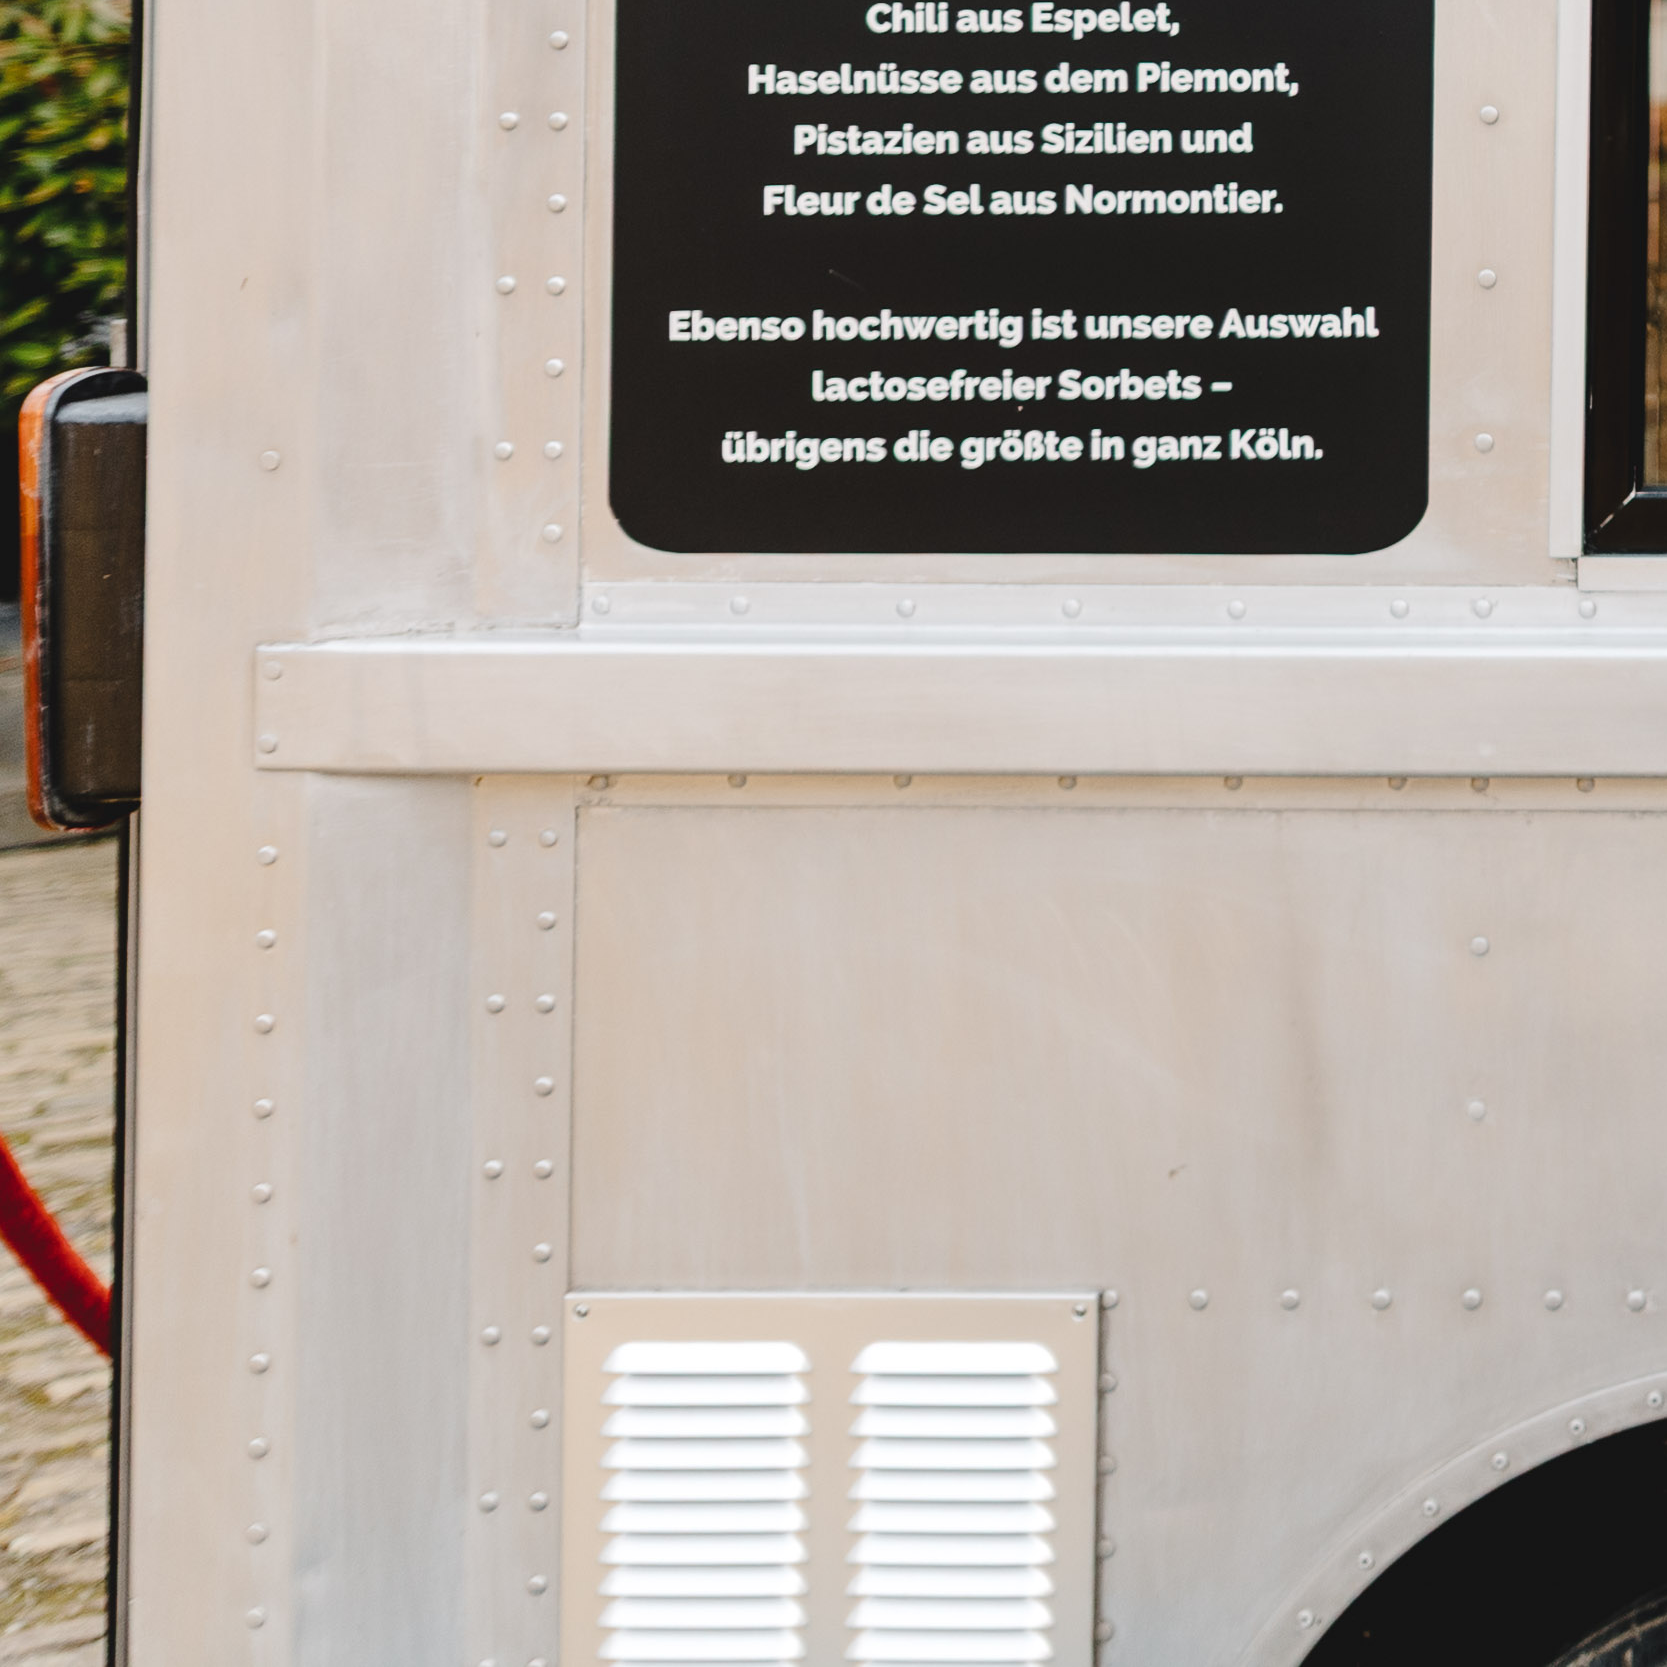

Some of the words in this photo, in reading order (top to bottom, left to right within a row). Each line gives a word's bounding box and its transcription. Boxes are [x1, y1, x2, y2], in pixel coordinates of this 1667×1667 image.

[865, 1, 949, 34] Chili
[955, 8, 1024, 33] aus
[1031, 1, 1180, 41] Espelet,
[748, 62, 964, 95] Haselnüsse
[969, 69, 1038, 94] aus
[1044, 61, 1129, 94] dem
[1137, 61, 1299, 97] Piemont,
[793, 122, 959, 156] Pistazien
[966, 129, 1035, 155] aus
[1041, 122, 1173, 154] Sizilien
[1180, 121, 1254, 154] und
[763, 184, 862, 216] Fleur
[865, 183, 917, 216] de
[922, 183, 985, 215] Sel
[989, 190, 1058, 215] aus
[1065, 181, 1284, 215] Normontier.
[668, 309, 806, 342] Ebenso
[812, 308, 1024, 348] hochwertig
[1031, 307, 1078, 340] ist
[1084, 314, 1214, 340] unsere
[1218, 306, 1380, 339] Auswahl
[812, 368, 1053, 402] lactosefreier
[1057, 368, 1203, 401] Sorbets
[721, 430, 888, 471] übrigens
[893, 429, 954, 462] die
[960, 429, 1084, 470] größte
[1090, 428, 1125, 461] in
[1132, 435, 1222, 469] ganz
[1230, 427, 1324, 460] Köln.
